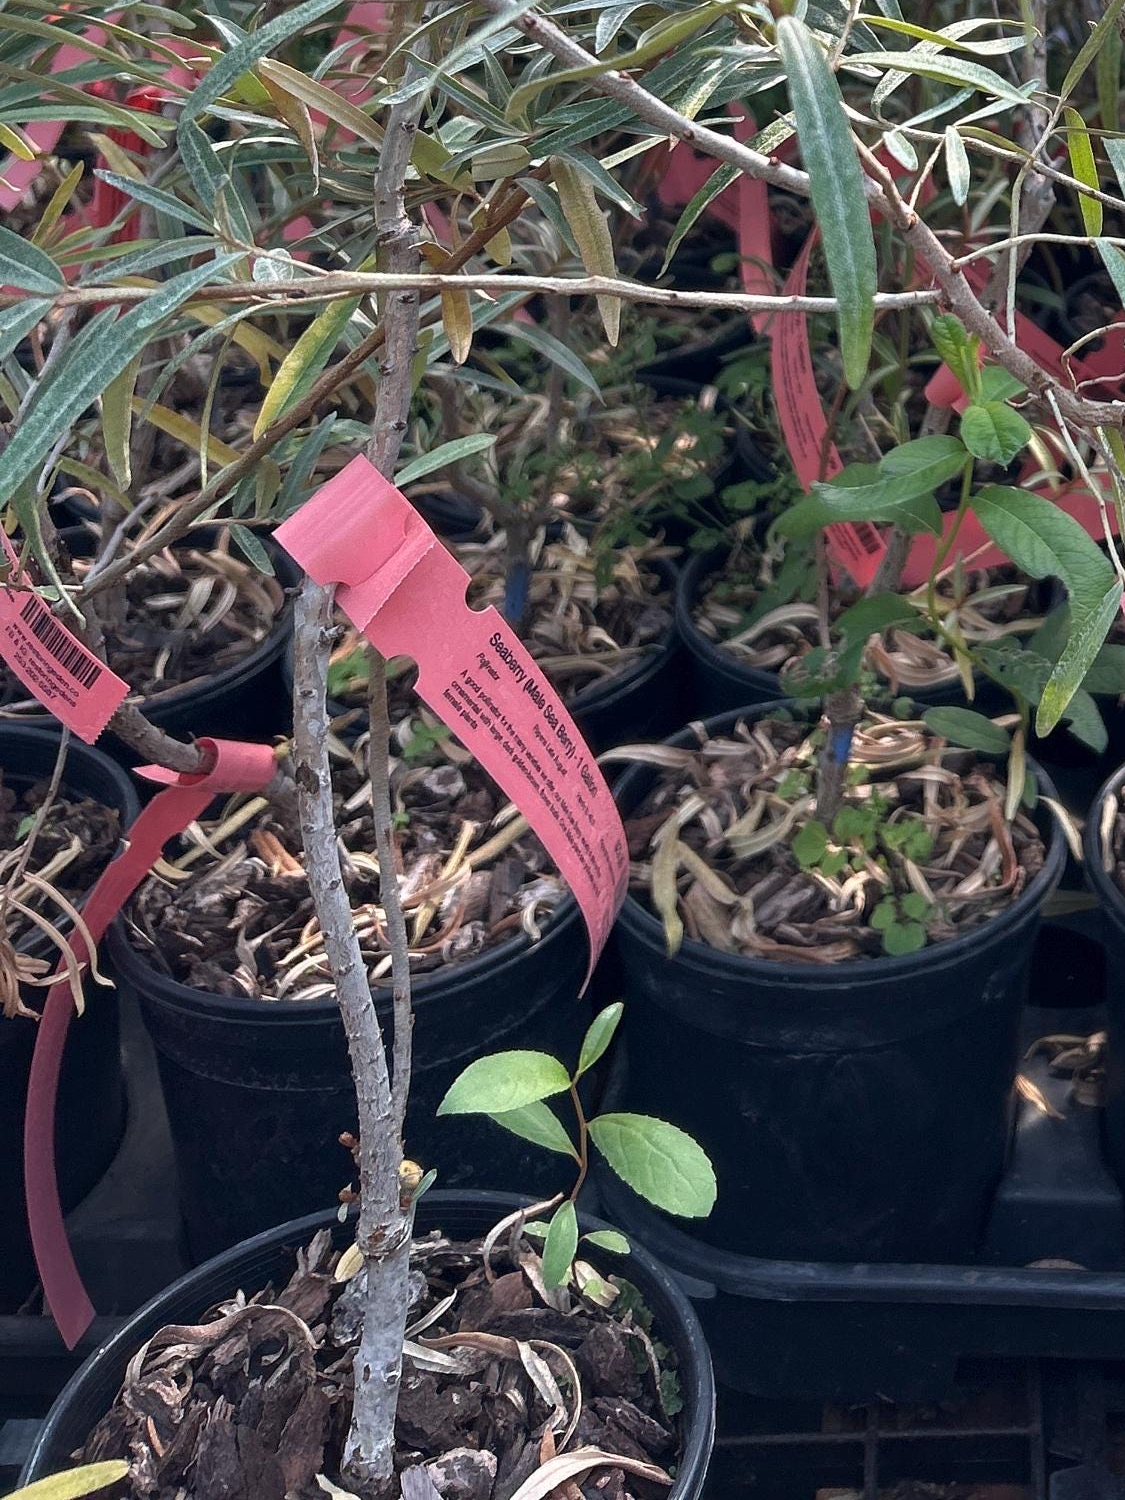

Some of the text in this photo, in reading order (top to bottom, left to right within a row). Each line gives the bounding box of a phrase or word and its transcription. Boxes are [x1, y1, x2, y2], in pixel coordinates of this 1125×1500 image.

[442, 688, 463, 712] female
[451, 680, 483, 715] ornamental
[479, 712, 491, 727] with
[460, 669, 468, 678] A
[464, 676, 482, 693] good
[477, 691, 502, 719] pollinator
[506, 724, 515, 736] the
[513, 734, 527, 753] many
[489, 632, 527, 684] Seaberry
[522, 678, 545, 710] (Male
[543, 704, 559, 731] Sea
[556, 723, 576, 760] Berry)
[576, 757, 584, 769] 1
[580, 764, 598, 798] Gallon
